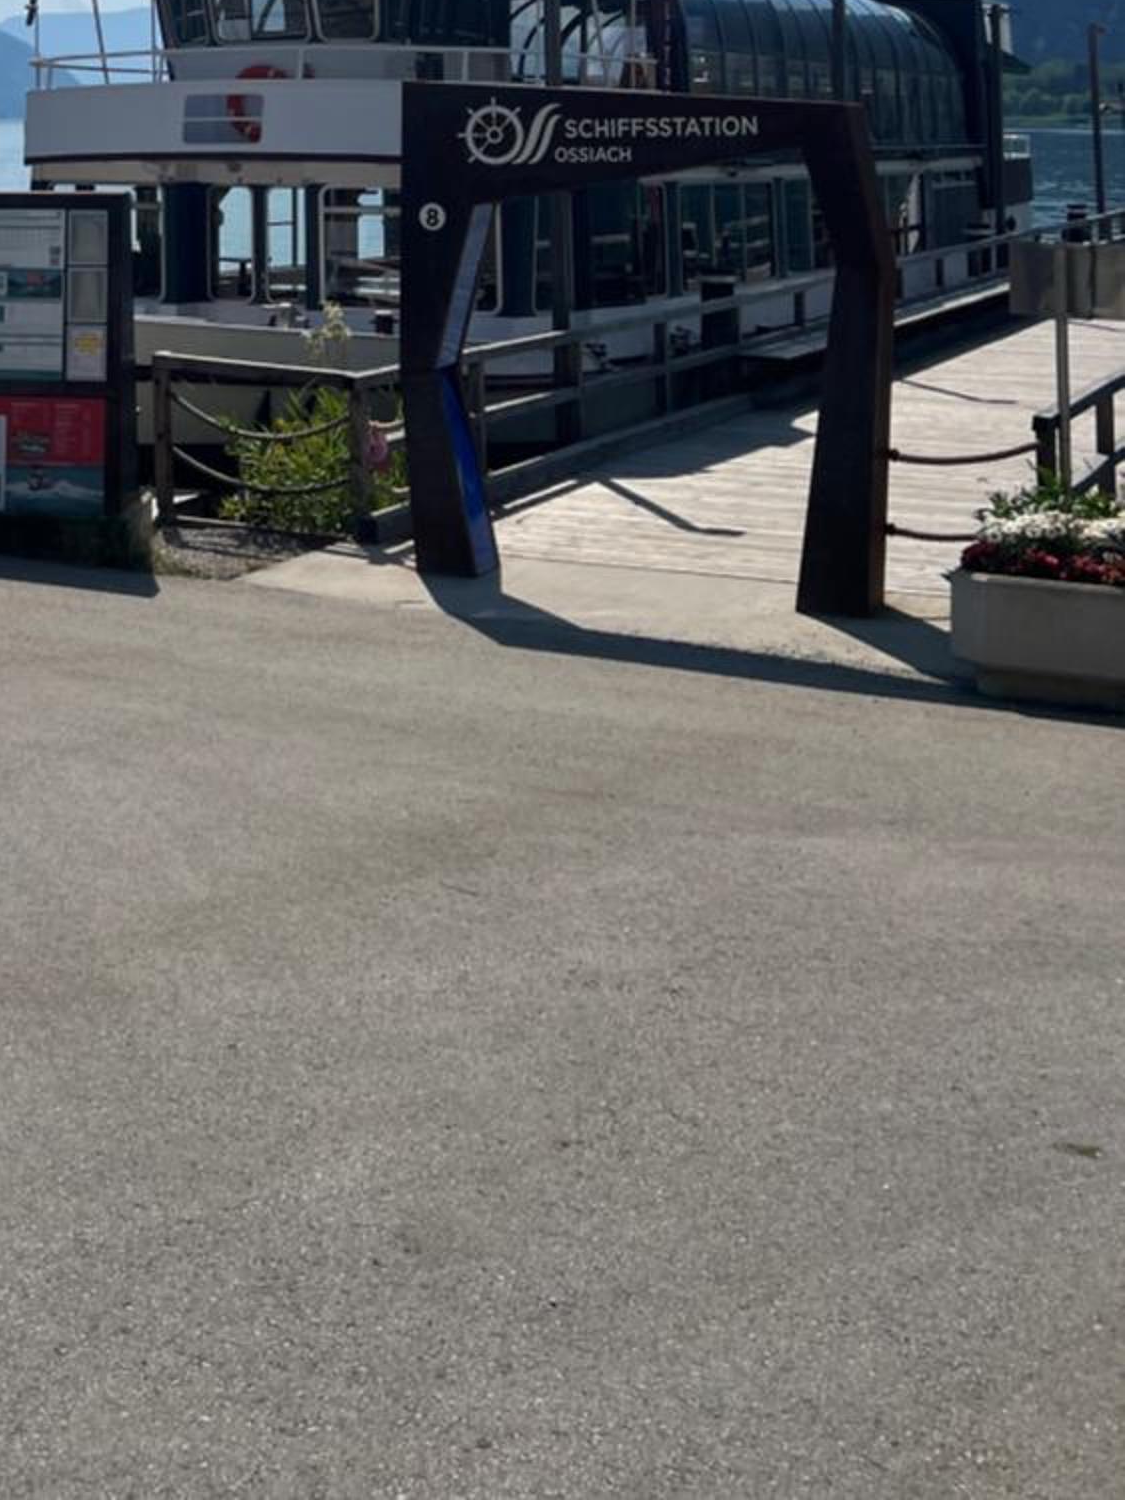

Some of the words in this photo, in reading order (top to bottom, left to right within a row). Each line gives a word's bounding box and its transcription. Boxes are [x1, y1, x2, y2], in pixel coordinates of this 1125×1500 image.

[564, 115, 759, 139] SCHIFFSSTATION
[554, 146, 632, 164] OSSIACH
[427, 207, 439, 227] 8
